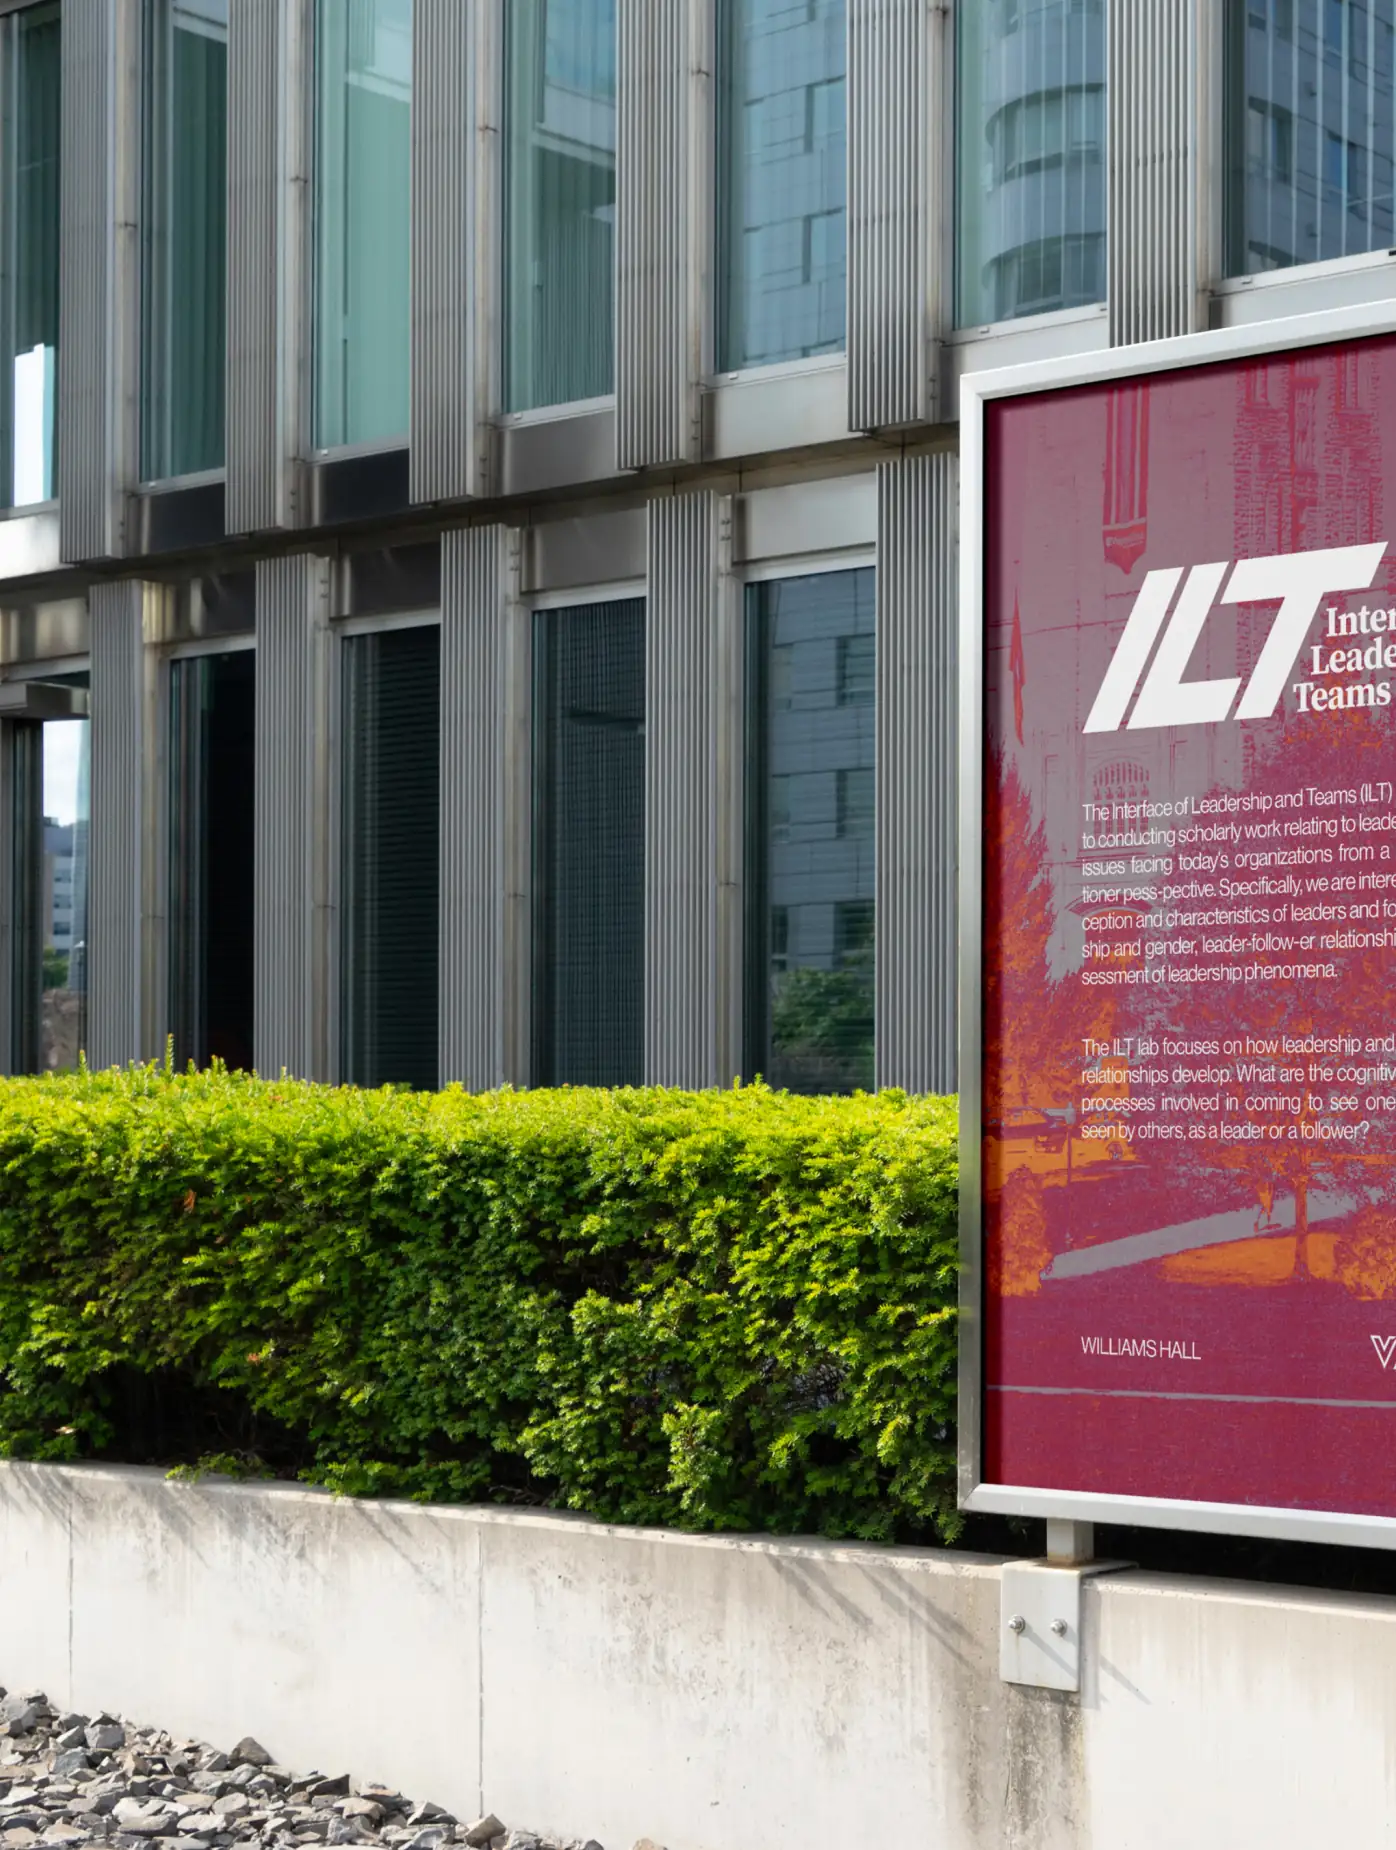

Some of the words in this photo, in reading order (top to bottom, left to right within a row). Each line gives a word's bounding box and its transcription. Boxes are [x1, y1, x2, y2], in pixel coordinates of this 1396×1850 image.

[1082, 541, 1389, 733] ILT
[1293, 679, 1391, 713] Teams
[1082, 804, 1112, 821] The
[1113, 800, 1172, 819] Interface
[1174, 797, 1189, 815] of
[1192, 792, 1273, 814] Leadership
[1275, 790, 1303, 808] and
[1306, 787, 1356, 805] Teams
[1360, 782, 1392, 804] (ILT)
[1082, 834, 1096, 849] to
[1098, 828, 1175, 848] conducting
[1179, 824, 1241, 843] scholarly
[1244, 820, 1280, 839] work
[1284, 817, 1337, 837] relating
[1341, 816, 1356, 832] to
[1082, 860, 1125, 876] issues
[1132, 856, 1172, 875] facing
[1235, 846, 1332, 871] organizations
[1339, 843, 1374, 861] from
[1380, 845, 1390, 860] a
[1082, 888, 1124, 903] tioner
[1220, 874, 1303, 896] Specifically,
[1306, 876, 1328, 892] we
[1331, 874, 1356, 890] are
[1082, 912, 1132, 932] ception
[1136, 907, 1163, 928] and
[1166, 905, 1269, 926] characteristics
[1273, 904, 1288, 921] of
[1292, 904, 1346, 921] leaders
[1349, 900, 1379, 919] and
[1082, 940, 1109, 960] ship
[1114, 939, 1141, 957] and
[1145, 938, 1198, 959] gender,
[1082, 969, 1148, 985] sessment
[1152, 966, 1167, 983] of
[1168, 964, 1242, 983] leadership
[1245, 963, 1338, 983] phenomena.
[1082, 1038, 1109, 1056] The
[1113, 1038, 1134, 1056] ILT
[1138, 1038, 1159, 1056] lab
[1163, 1037, 1219, 1055] focuses
[1223, 1040, 1242, 1055] on
[1246, 1036, 1279, 1055] how
[1282, 1034, 1361, 1056] leadership
[1365, 1034, 1394, 1052] and
[1082, 1065, 1168, 1085] relationships
[1172, 1065, 1232, 1086] develop.
[1237, 1064, 1275, 1082] What
[1279, 1067, 1304, 1082] are
[1309, 1064, 1333, 1081] the
[1082, 1095, 1155, 1114] processes
[1161, 1093, 1219, 1112] involved
[1226, 1094, 1238, 1111] in
[1245, 1093, 1300, 1114] coming
[1308, 1094, 1322, 1110] to
[1330, 1094, 1358, 1111] see
[1082, 1123, 1116, 1139] seen
[1118, 1121, 1136, 1142] by
[1138, 1122, 1186, 1140] others,
[1189, 1124, 1206, 1139] as
[1208, 1124, 1217, 1139] a
[1221, 1121, 1264, 1139] leader
[1268, 1123, 1284, 1139] or
[1288, 1124, 1297, 1139] a
[1301, 1121, 1370, 1140] follower?
[1081, 1336, 1158, 1358] WILLIAMS
[1160, 1339, 1202, 1360] HALL
